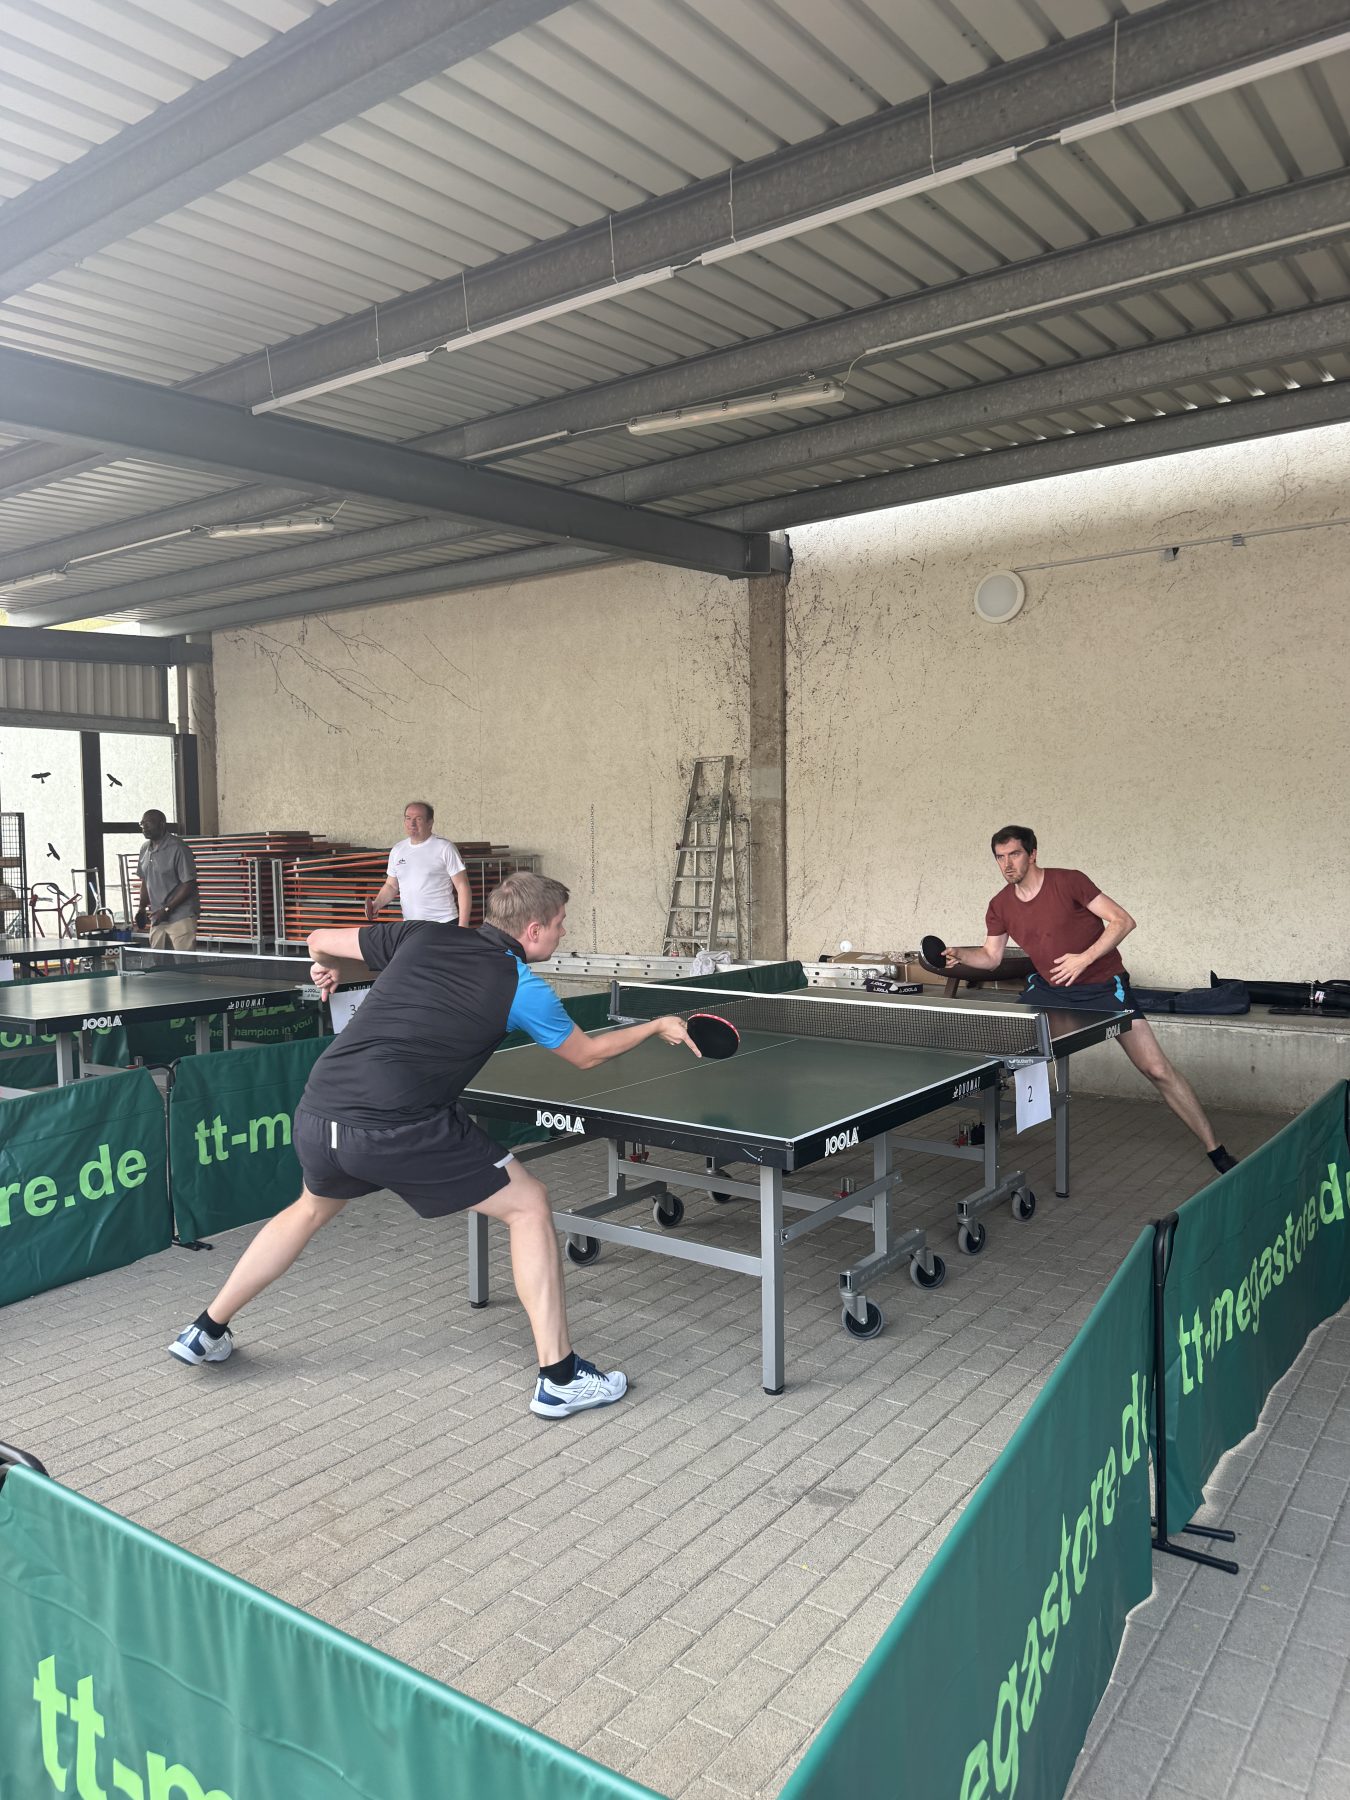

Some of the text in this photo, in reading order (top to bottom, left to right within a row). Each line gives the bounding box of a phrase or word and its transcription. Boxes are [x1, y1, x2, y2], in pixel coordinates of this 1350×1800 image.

[105, 948, 119, 956] JOO
[235, 997, 266, 1009] DUOMAT
[349, 1004, 357, 1016] 3
[82, 1015, 122, 1031] JOOLA
[1105, 1023, 1121, 1040] JOOLA
[234, 1026, 279, 1039] hampion
[282, 1026, 291, 1035] in
[958, 1076, 981, 1096] DUOMAT
[1027, 1085, 1034, 1103] 2
[535, 1110, 586, 1135] JOOLA
[824, 1126, 860, 1158] JOOLA
[1178, 1162, 1350, 1396] tt-megastore.d
